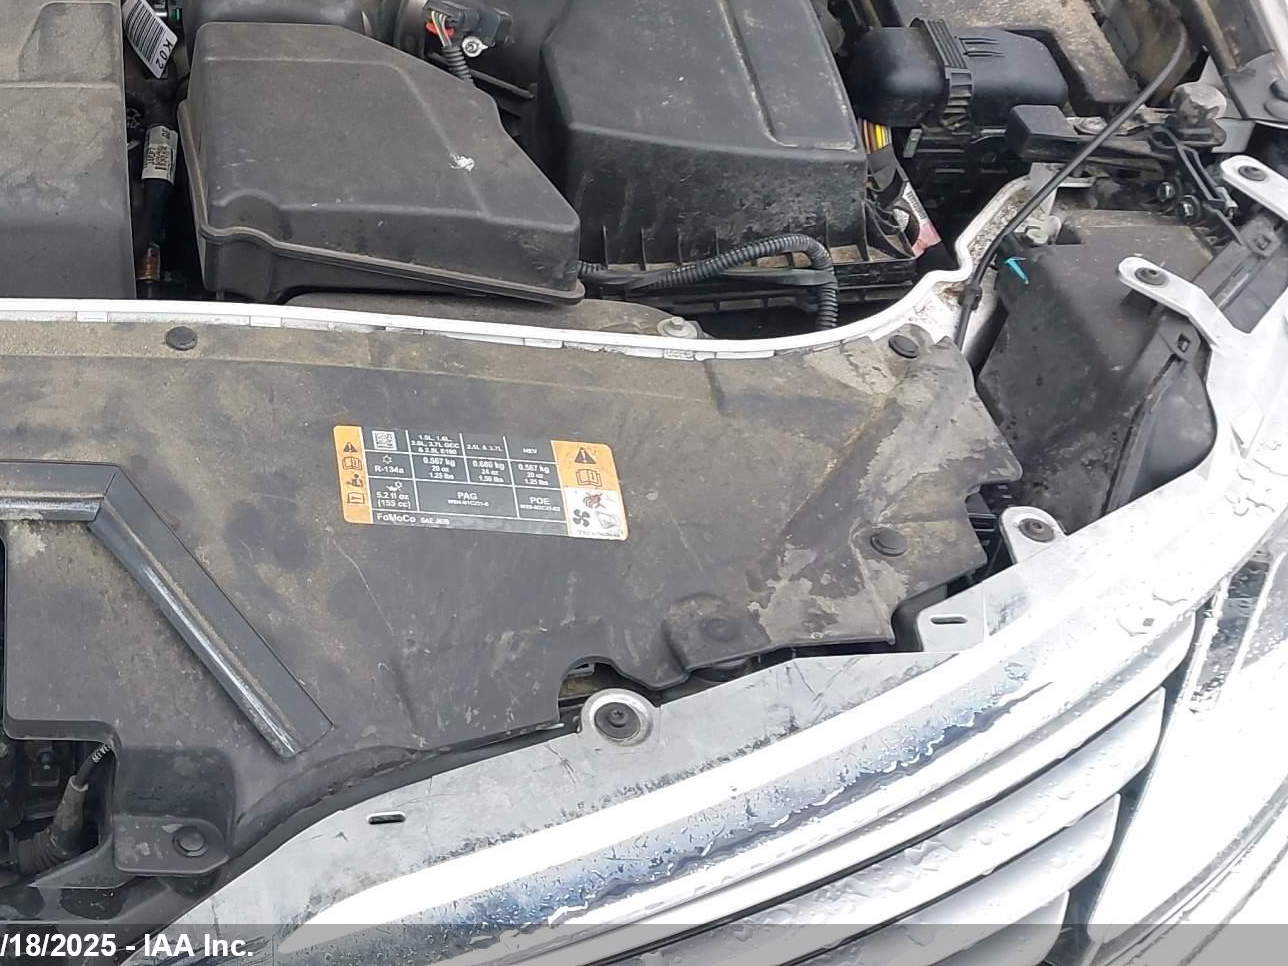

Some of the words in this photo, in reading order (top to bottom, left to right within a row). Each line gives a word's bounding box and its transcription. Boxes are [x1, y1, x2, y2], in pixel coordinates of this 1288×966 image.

[156, 38, 174, 70] K02
[444, 458, 456, 467] kg
[494, 461, 505, 470] kg
[374, 465, 404, 474] R-134a
[539, 465, 550, 474] kg
[376, 491, 390, 499] 5.2
[457, 491, 478, 500] PAG
[377, 499, 396, 507] (155
[397, 501, 411, 509] cc)
[529, 496, 551, 505] POE
[376, 513, 416, 523] FoMoCo
